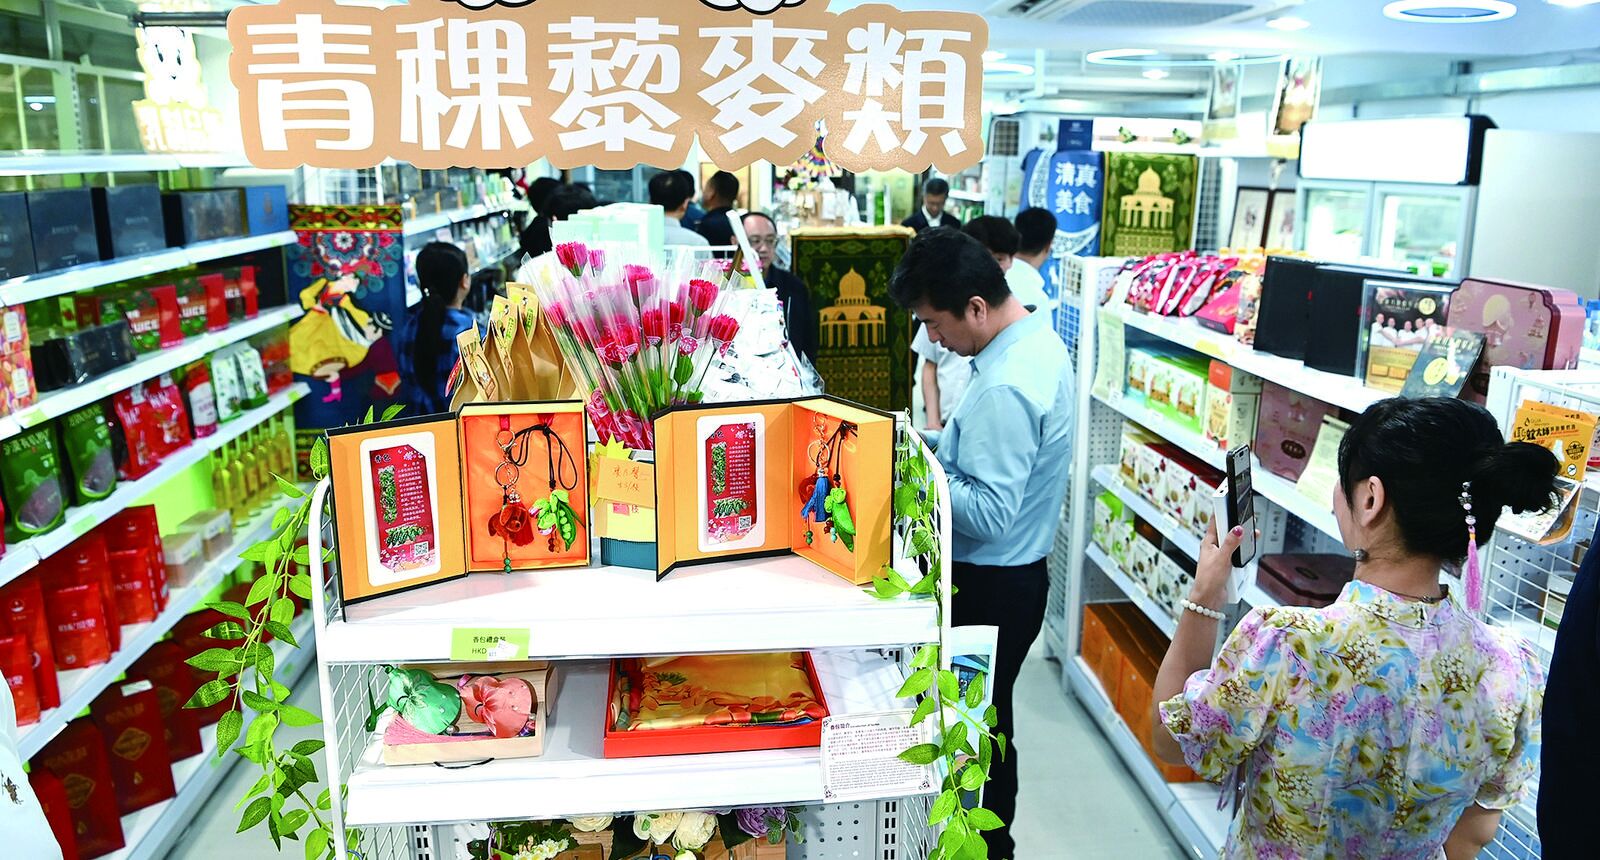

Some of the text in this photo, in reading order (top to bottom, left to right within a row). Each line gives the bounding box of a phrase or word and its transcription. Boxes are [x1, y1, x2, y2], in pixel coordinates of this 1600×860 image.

[246, 13, 972, 154] 青稞藜麥類
[1055, 161, 1098, 188] 清真
[1055, 189, 1093, 215] 美食
[471, 647, 487, 655] HKD
